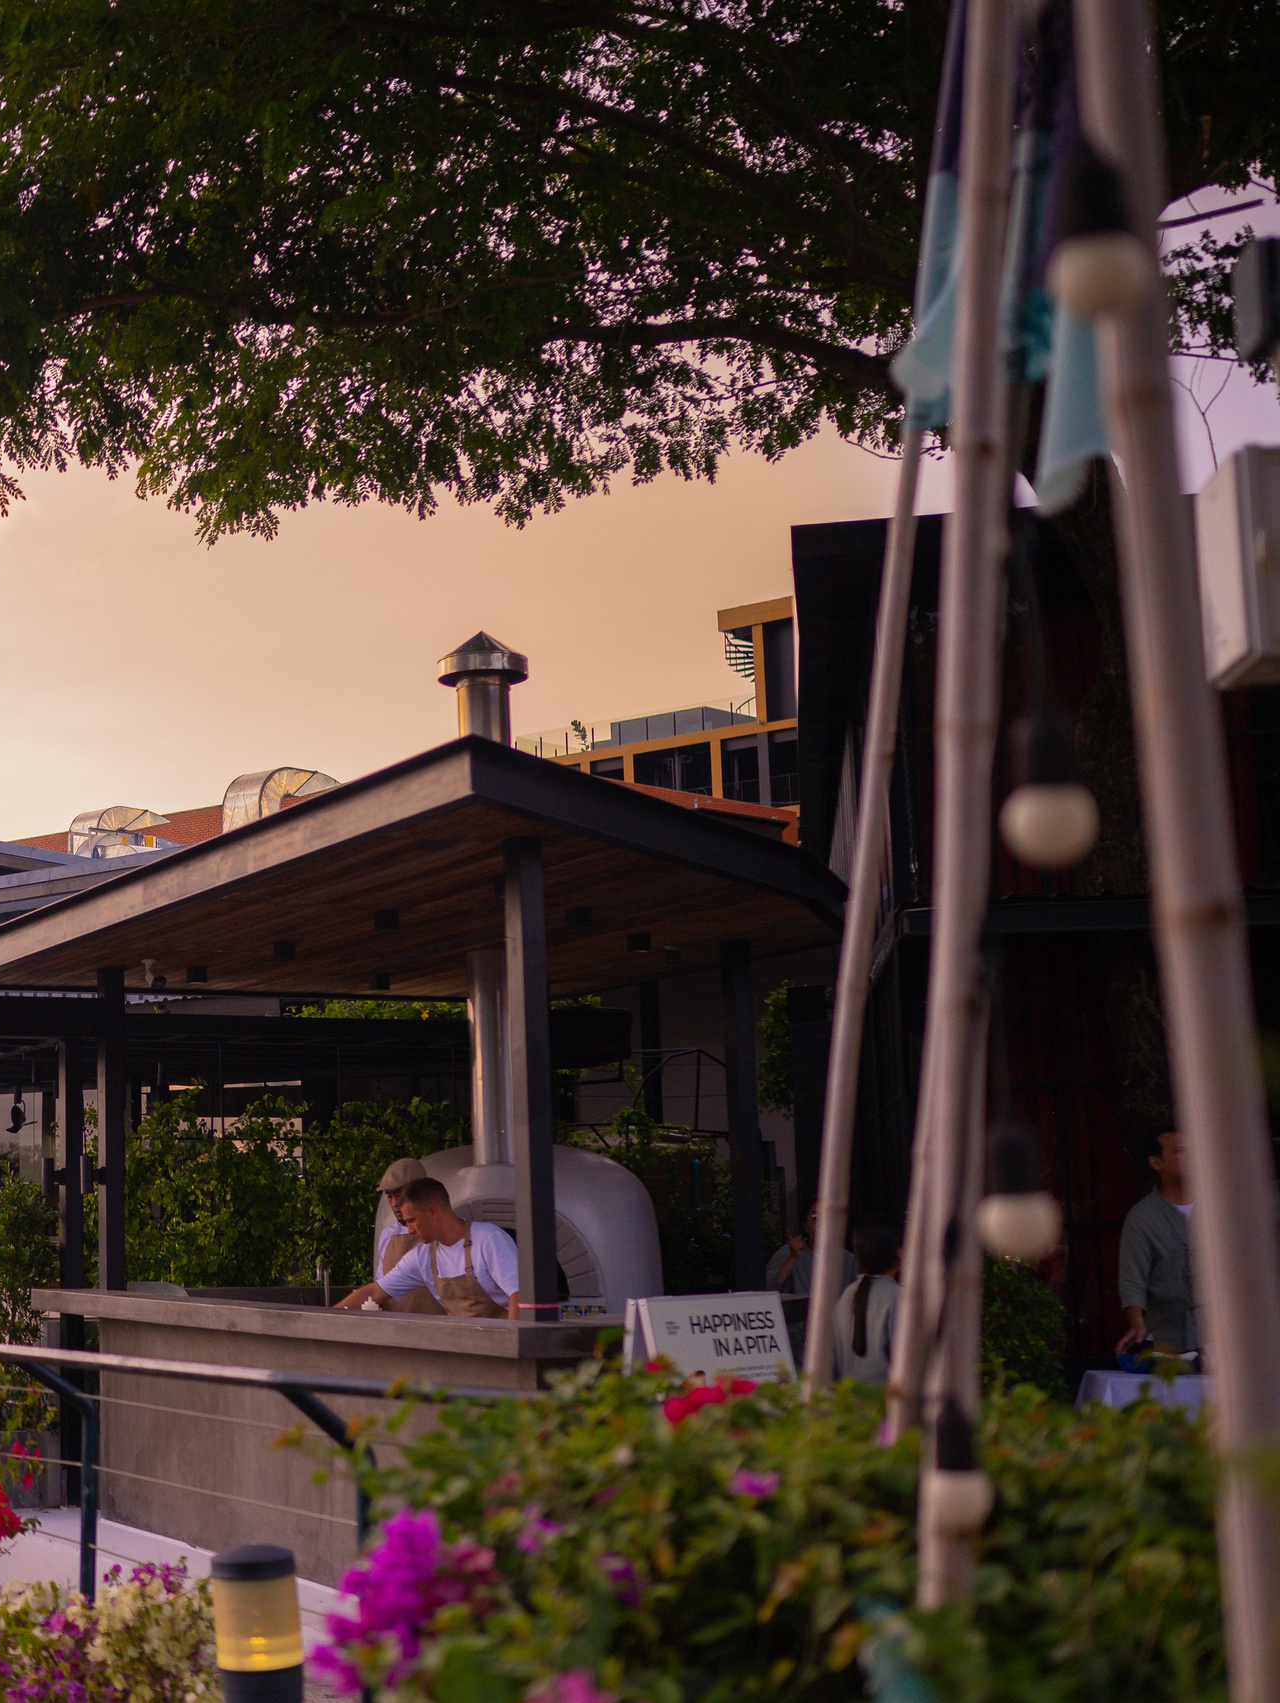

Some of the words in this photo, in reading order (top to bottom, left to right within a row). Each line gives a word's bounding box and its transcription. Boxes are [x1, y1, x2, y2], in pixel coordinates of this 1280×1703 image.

[689, 1311, 775, 1334] HAPPINESS
[713, 1338, 731, 1357] IN
[733, 1337, 746, 1356] A
[745, 1334, 781, 1355] PITA
